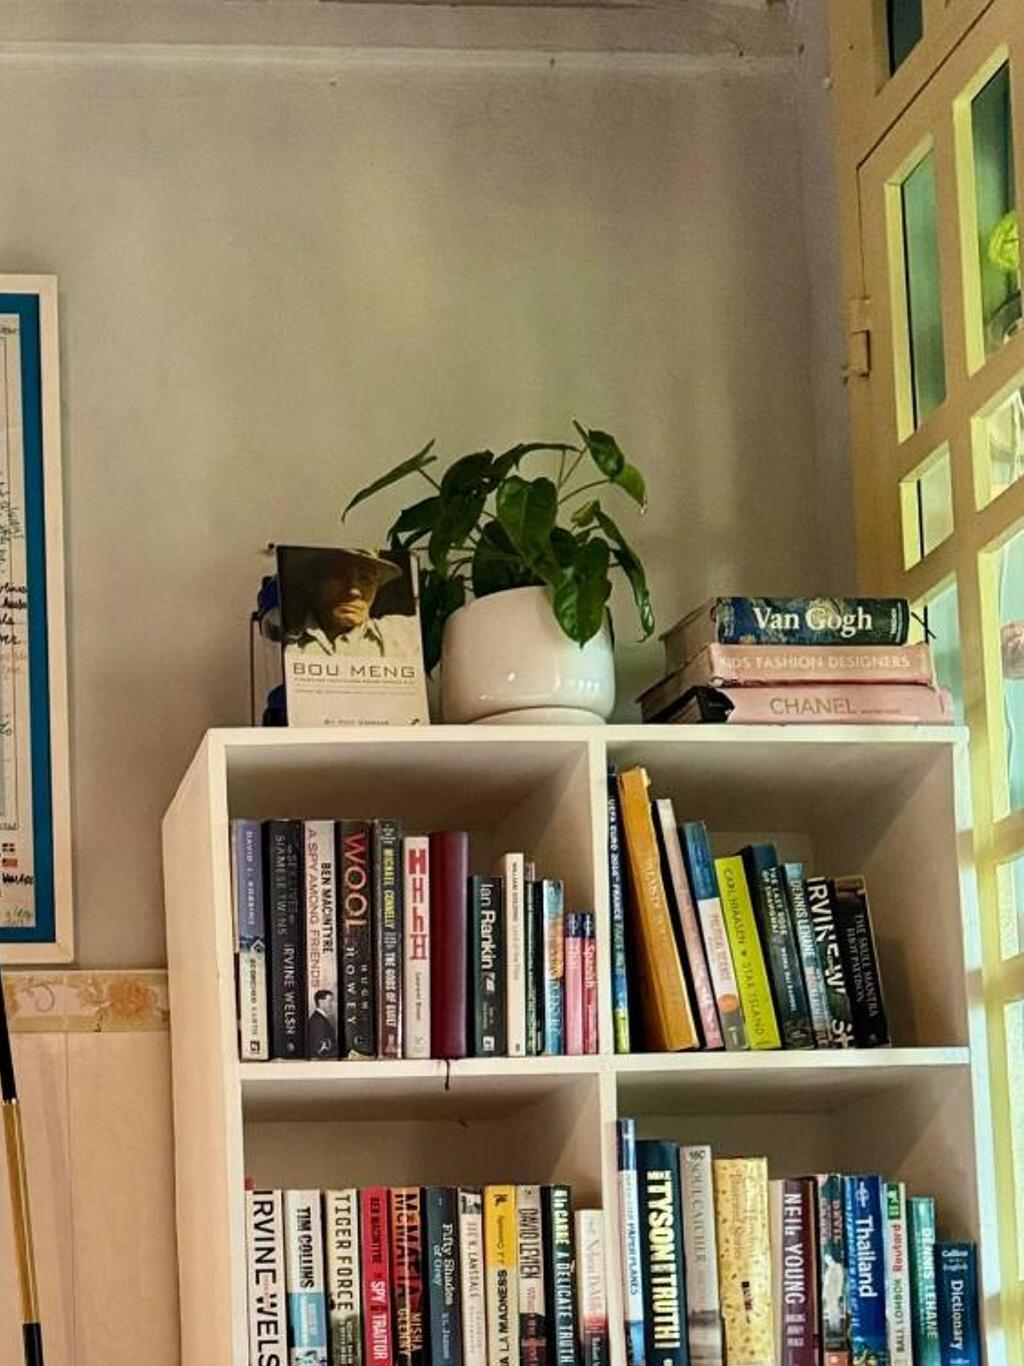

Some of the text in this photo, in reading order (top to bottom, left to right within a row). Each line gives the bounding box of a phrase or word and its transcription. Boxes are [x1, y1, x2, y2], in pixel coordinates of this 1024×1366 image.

[753, 607, 799, 630] Van
[805, 607, 873, 638] Gogh
[293, 663, 415, 678] BOU MENG
[828, 655, 910, 668] DESIGNERS
[770, 698, 857, 714] CHANEL
[308, 829, 321, 988] A SPY AMONG FRIENDS
[321, 862, 333, 954] BEN MACINTYRE
[344, 832, 367, 934] WOOL
[383, 848, 395, 929] MICHAEL CONNELLY
[790, 880, 808, 918] DENNIS
[480, 884, 496, 970] Ian Rankin
[283, 944, 295, 1035] IRVINE WELSH
[345, 946, 356, 1025] HOWEY
[384, 952, 395, 967] THE
[385, 969, 395, 990] GODS
[583, 944, 595, 988] Spanish
[742, 962, 754, 988] STAR
[385, 992, 396, 1002] OF
[297, 1206, 312, 1232] TIM
[335, 1195, 352, 1250] TIGER
[518, 1208, 541, 1279] DAVID LEVIEN
[647, 1180, 677, 1263] TYSON
[783, 1193, 803, 1235] NEIL
[298, 1235, 314, 1288] COLLINS
[442, 1223, 458, 1305] Fifty Shades
[784, 1243, 805, 1305] YOUNG
[856, 1215, 877, 1298] Thailand
[893, 1224, 903, 1272] Routard
[337, 1256, 353, 1311] FORCE
[497, 1270, 509, 1333] MADNESS
[557, 1251, 573, 1363] A DELICATE TRUTH
[652, 1275, 679, 1340] TRUTH
[922, 1228, 937, 1339] DENNIS LEHANE
[949, 1279, 964, 1350] Dictionary
[370, 1281, 387, 1360] SPY TRAITOR
[411, 1312, 423, 1352] MISHA
